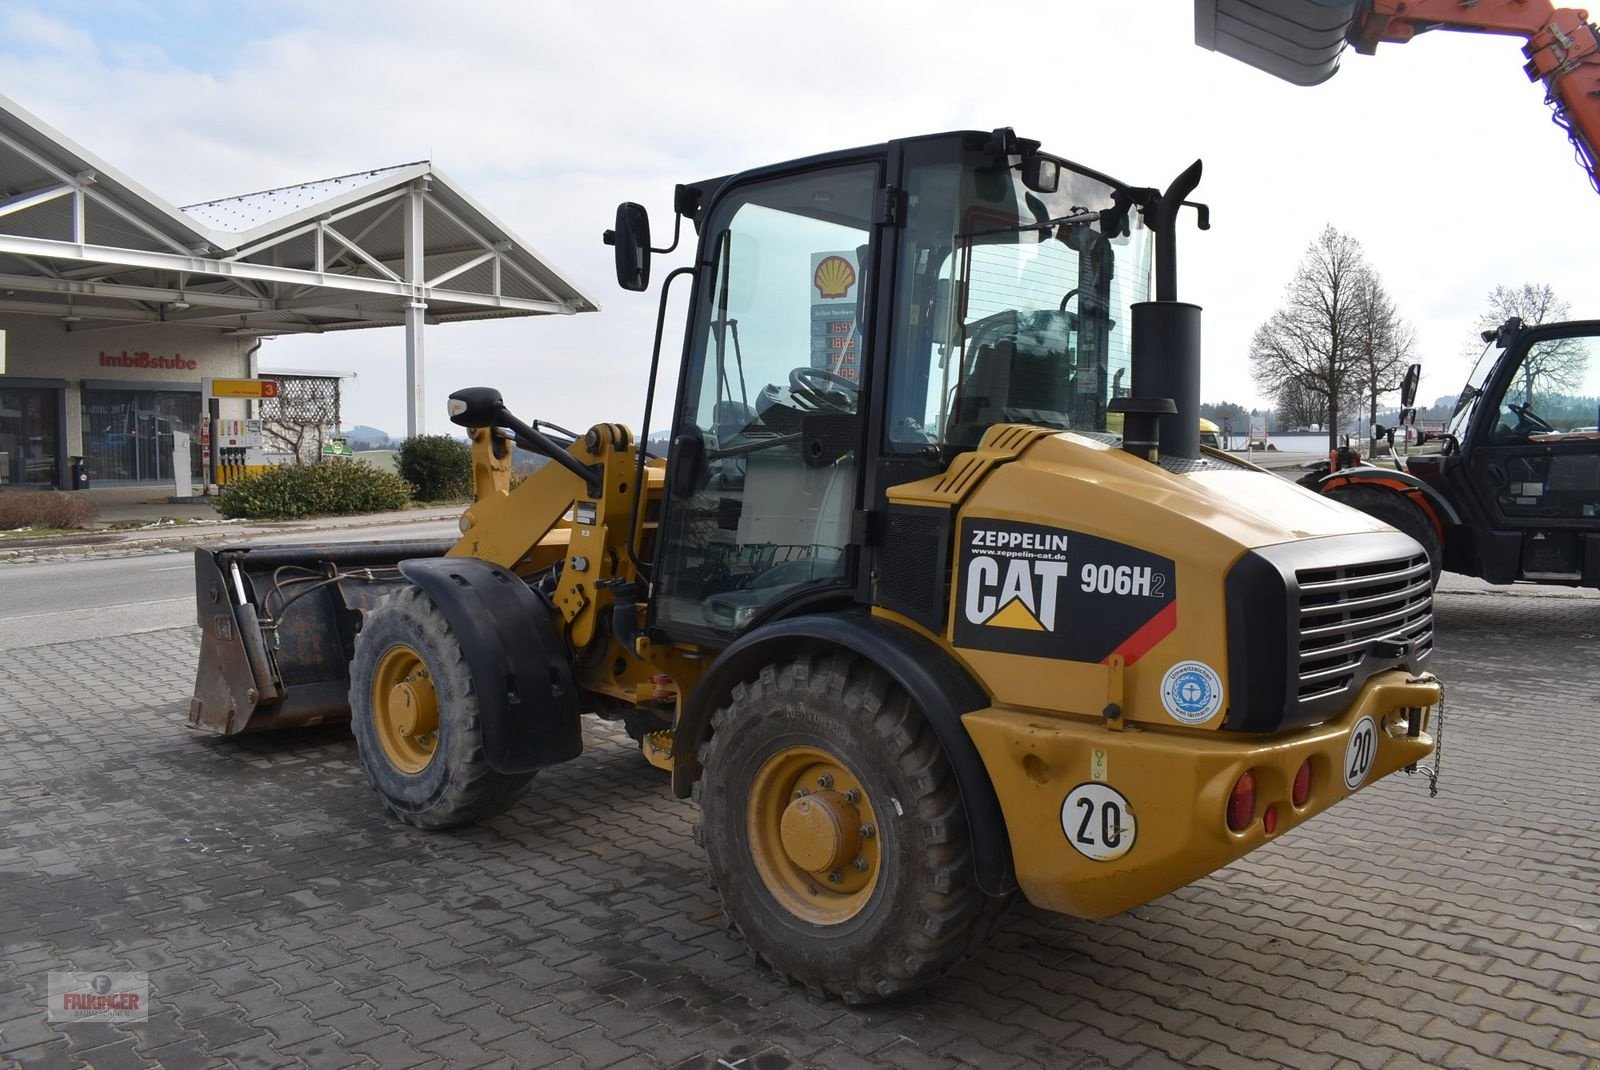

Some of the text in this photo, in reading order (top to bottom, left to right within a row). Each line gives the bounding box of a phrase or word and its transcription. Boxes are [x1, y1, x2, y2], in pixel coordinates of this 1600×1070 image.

[99, 351, 197, 370] Imbißstube
[265, 384, 274, 396] 3
[971, 529, 1068, 552] ZEPPELIN
[971, 547, 1067, 561] www.zeppelin-cat.de
[1080, 563, 1166, 598] 906H2
[965, 556, 1068, 632] CAT
[1169, 665, 1213, 682] Umweltzeichen
[1348, 727, 1372, 779] 20
[1076, 796, 1121, 848] 20
